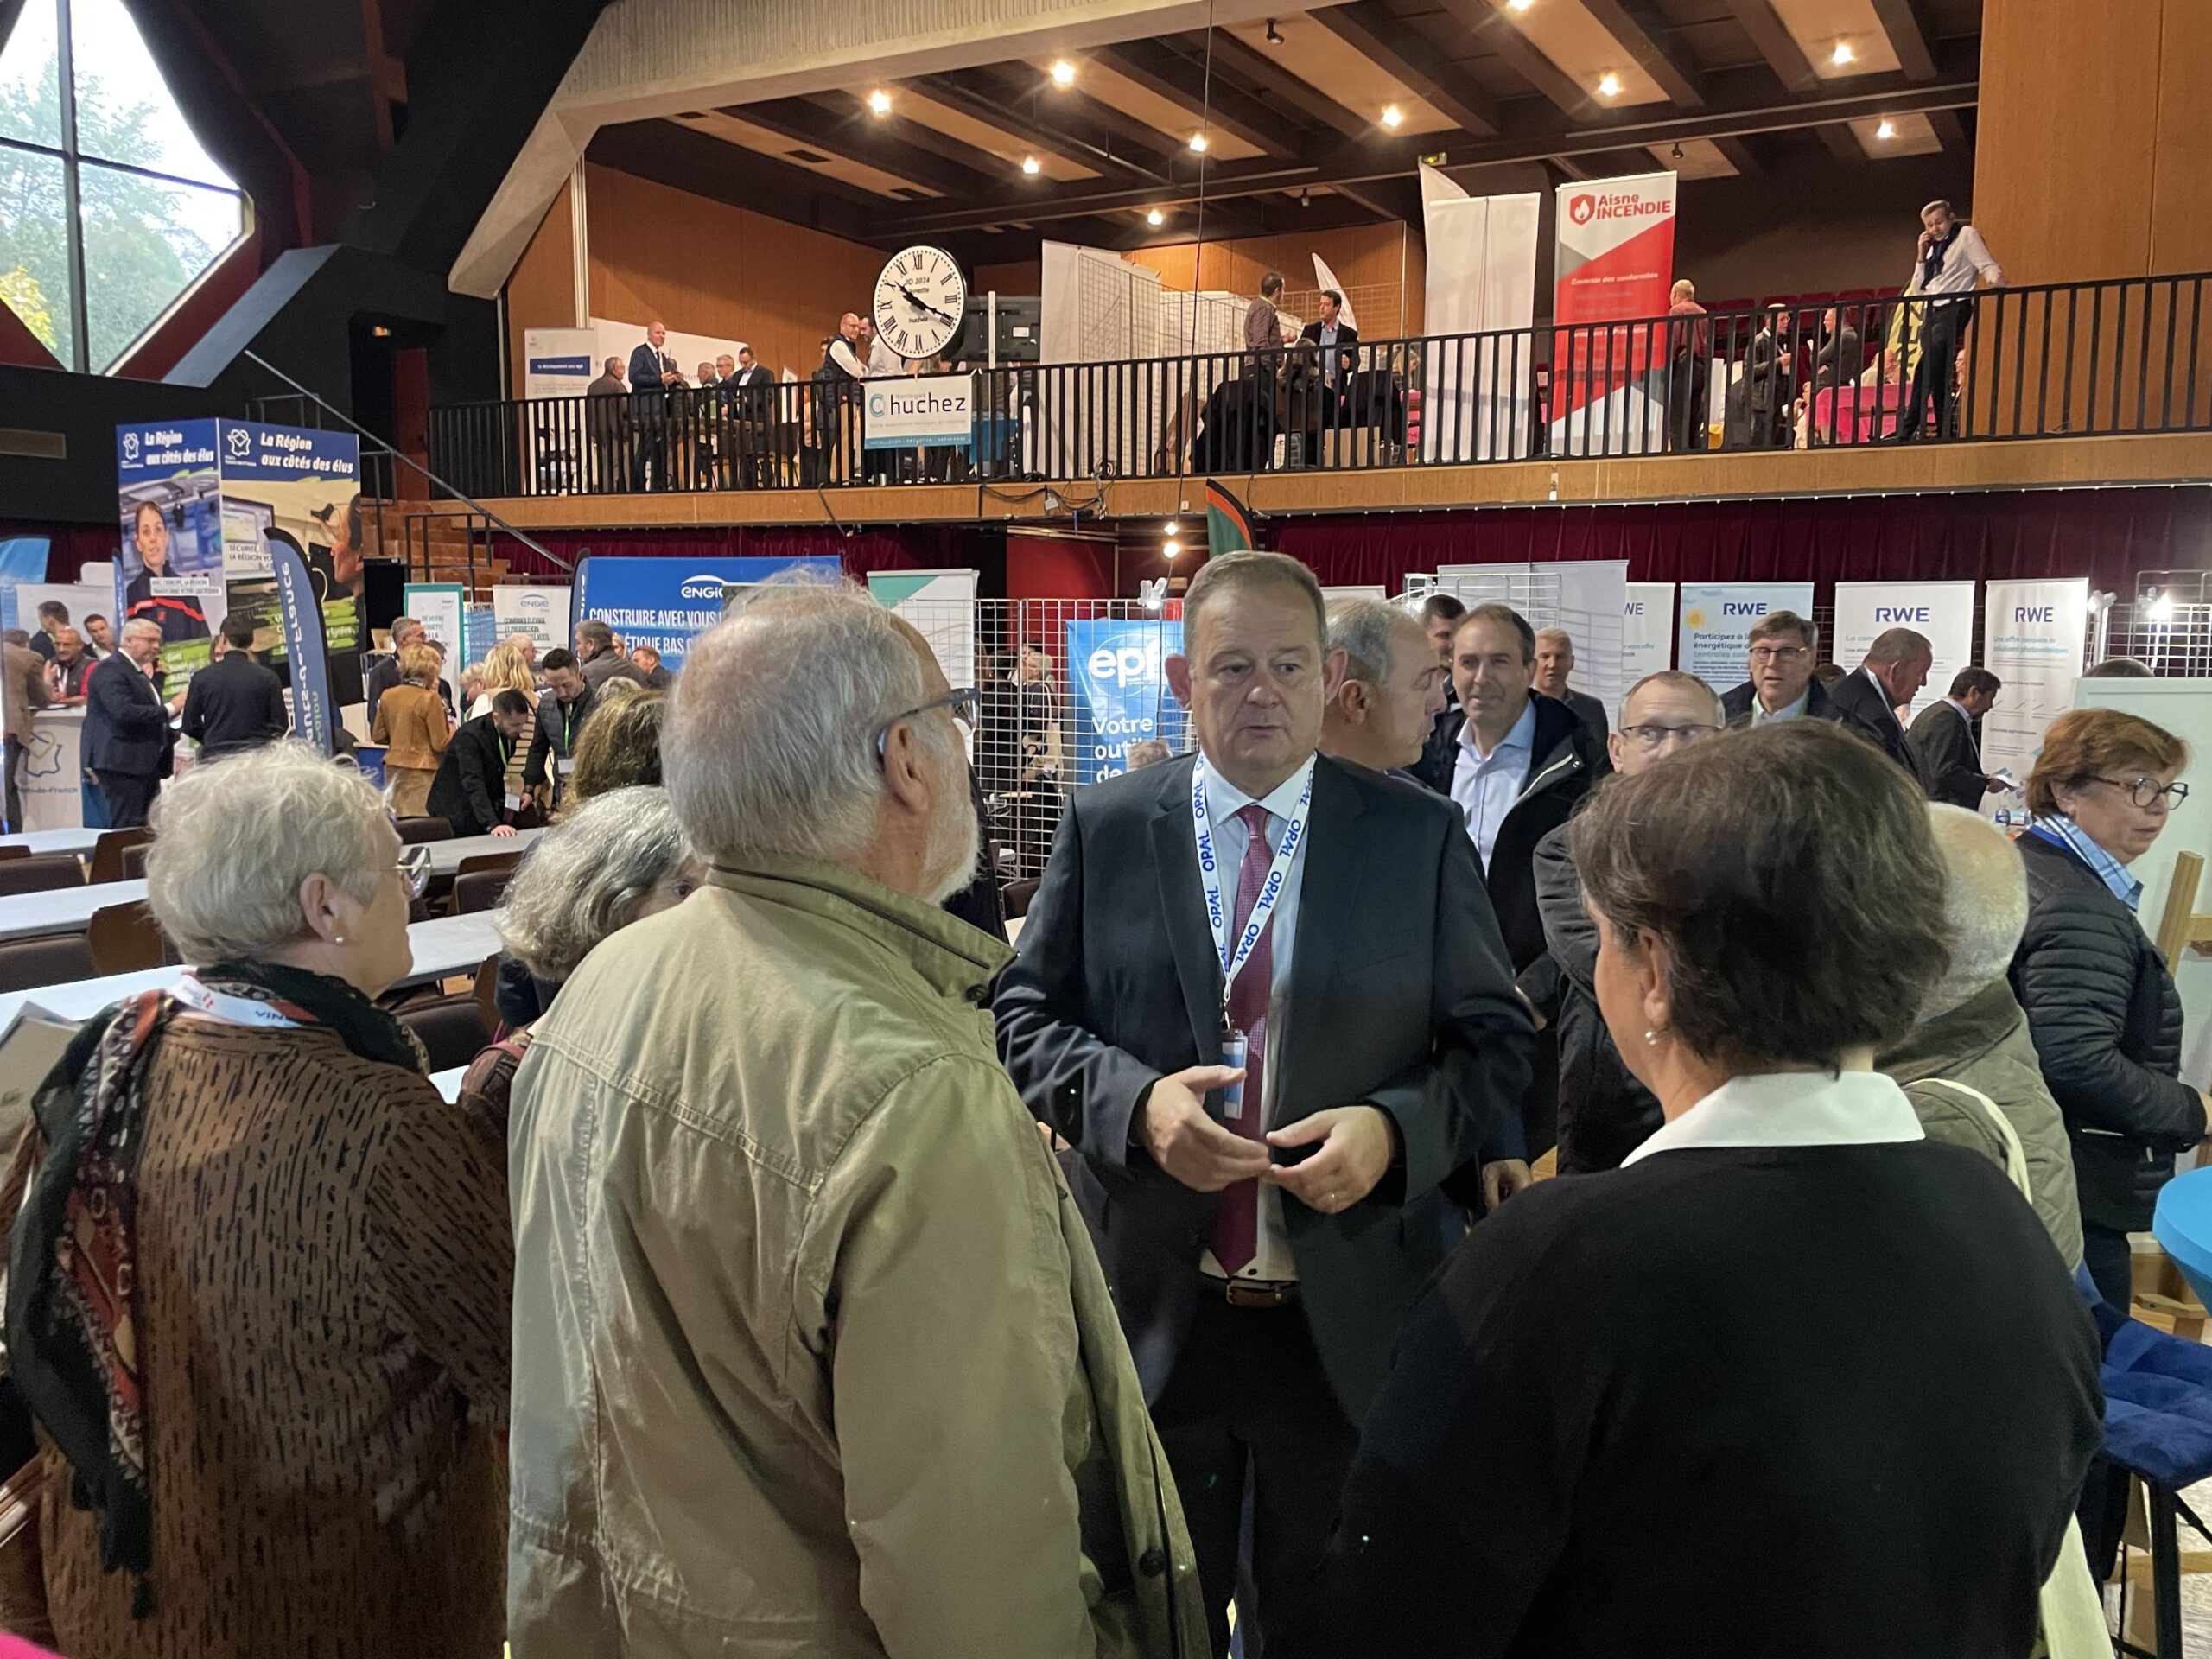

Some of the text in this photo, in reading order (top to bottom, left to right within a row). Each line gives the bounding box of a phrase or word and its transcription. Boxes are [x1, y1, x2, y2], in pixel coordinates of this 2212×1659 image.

[1597, 200, 1671, 219] INCENDIE
[1598, 194, 1639, 207] Aisne
[890, 391, 966, 415] huchez
[144, 430, 182, 448] La Région
[260, 432, 312, 452] La Région
[146, 454, 161, 466] aux
[162, 450, 182, 464] côtés
[183, 448, 197, 463] des
[198, 448, 214, 462] élus
[261, 454, 353, 474] aux côtés des élus
[589, 607, 655, 627] CONSTRUIRE
[658, 609, 685, 627] AVEC
[687, 610, 716, 628] VOUS
[1624, 602, 1643, 615] WE
[1723, 602, 1767, 615] RWE
[1876, 607, 1929, 622] RWE
[2015, 607, 2053, 622] RWE
[626, 632, 660, 654] ÉTIQUE
[664, 637, 683, 654] BAS
[1694, 632, 1735, 641] Participez
[1694, 642, 1743, 651] énergétique
[1091, 716, 1154, 734] Votre
[1095, 737, 1143, 760] out
[1193, 779, 1205, 819] OPAL
[1279, 819, 1301, 857] OPAL
[1198, 830, 1216, 872] OPAL
[1258, 871, 1282, 909] OPAL
[1207, 885, 1223, 928] OPAL
[1235, 924, 1260, 963] OPAL
[255, 1009, 284, 1020] VIN
